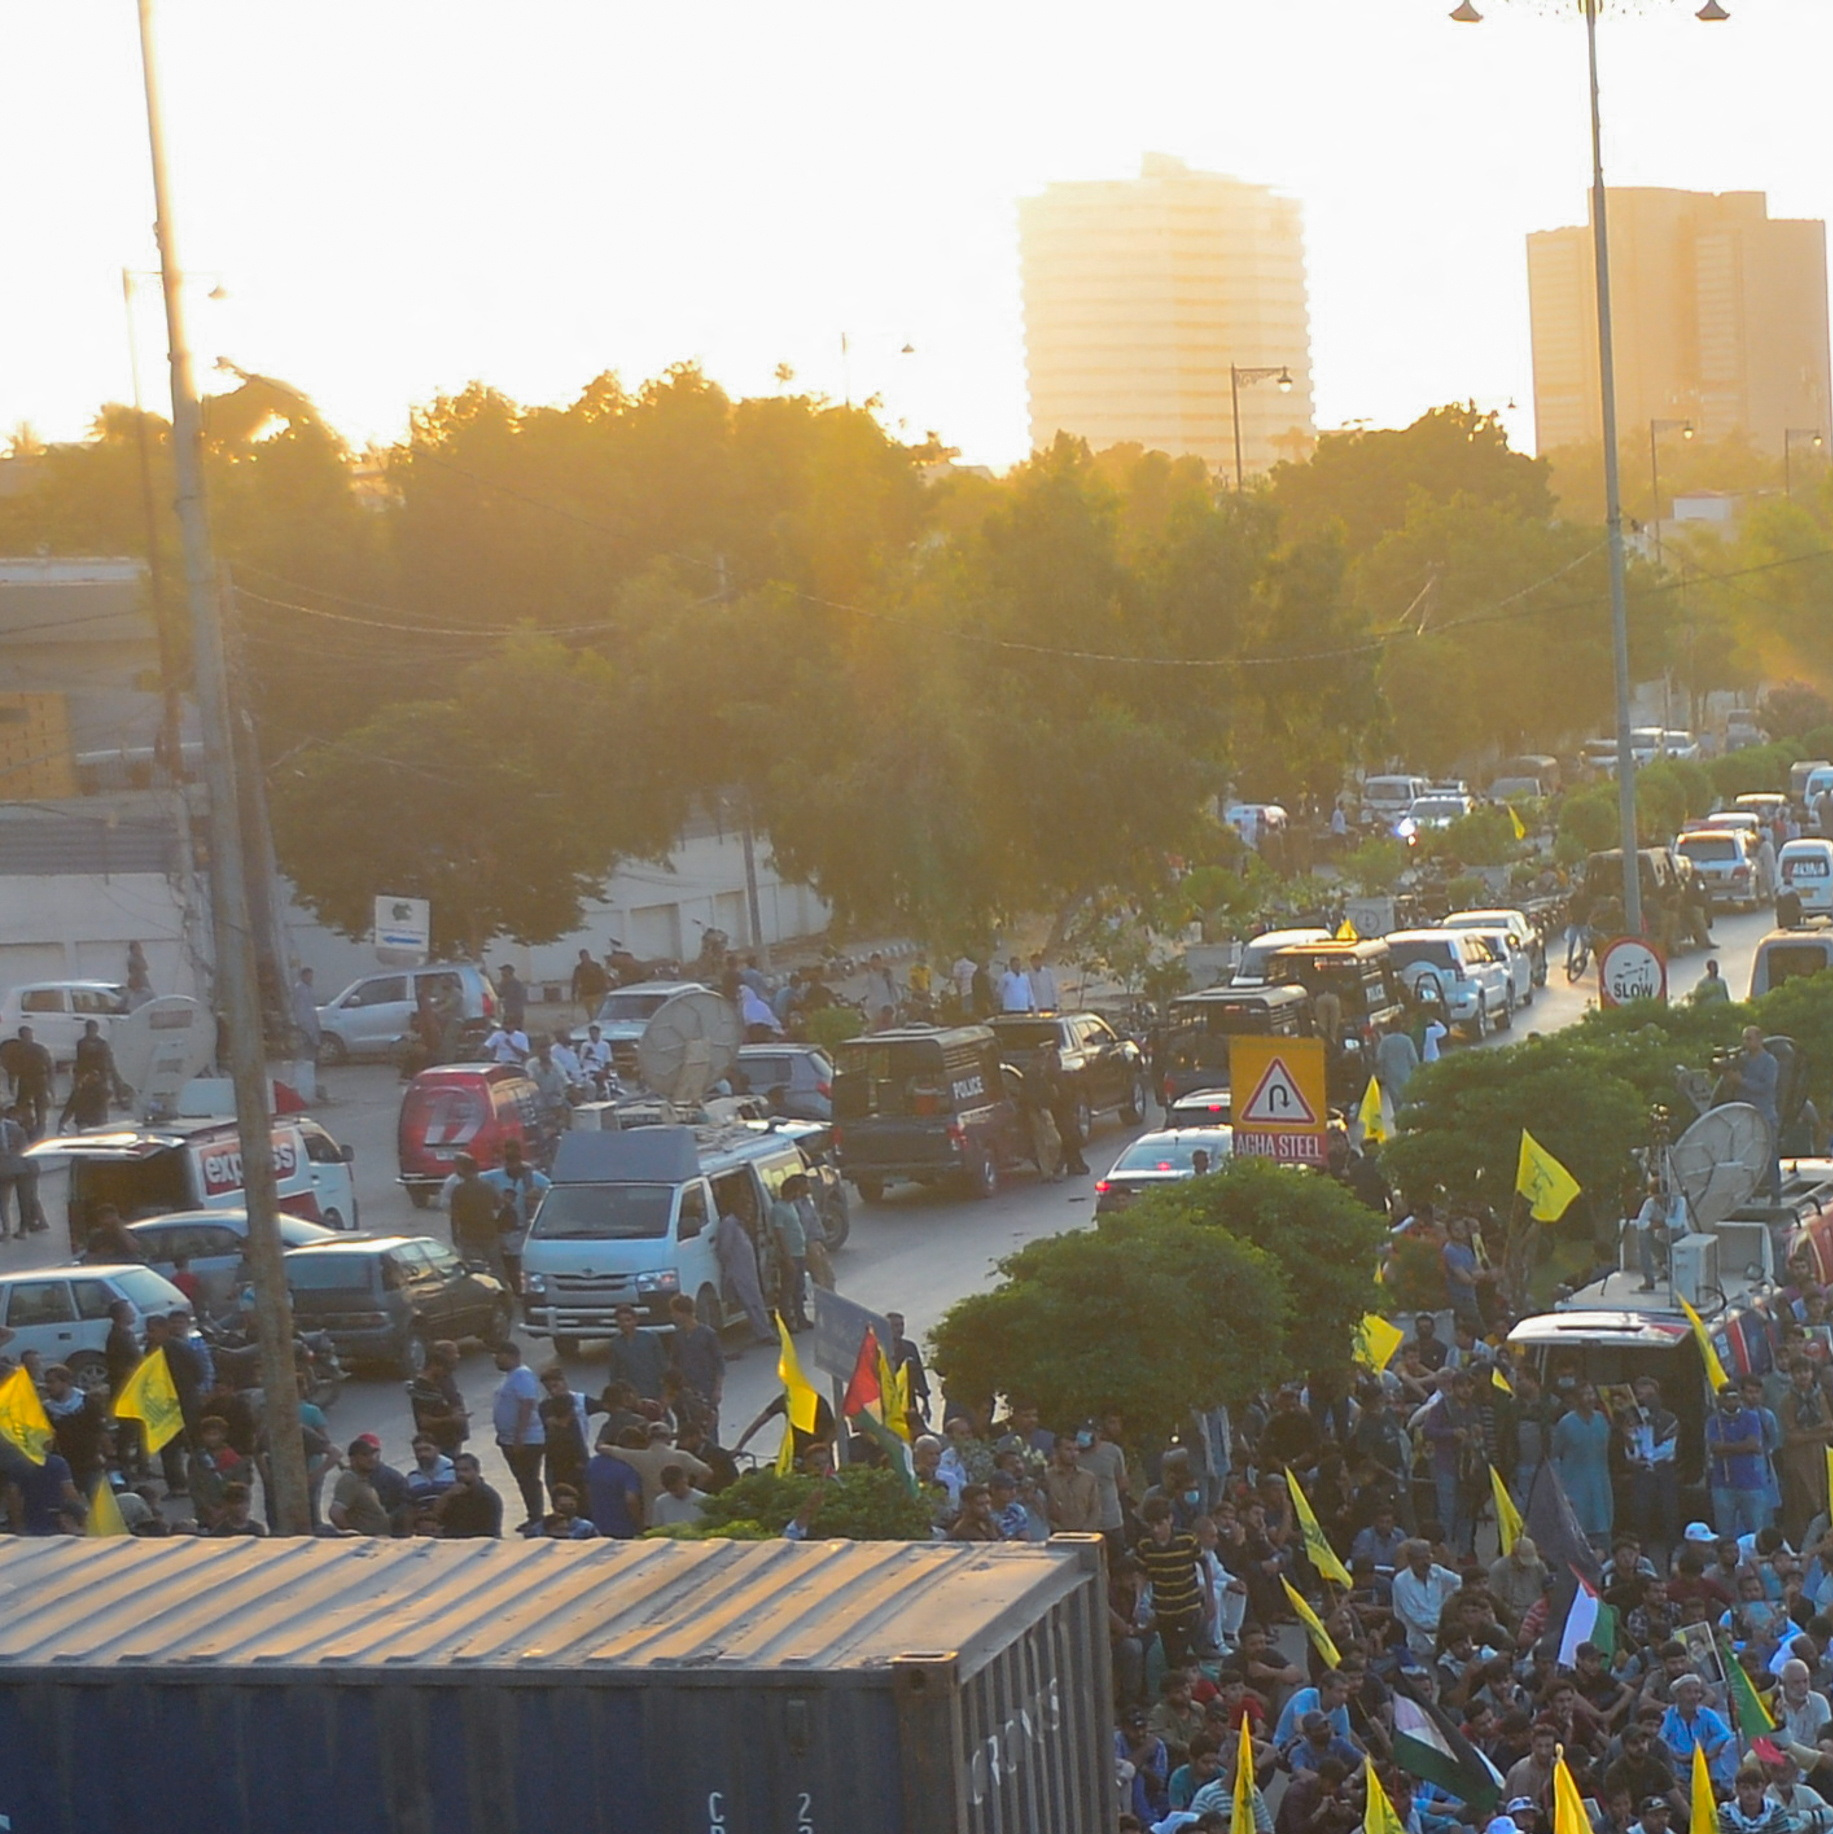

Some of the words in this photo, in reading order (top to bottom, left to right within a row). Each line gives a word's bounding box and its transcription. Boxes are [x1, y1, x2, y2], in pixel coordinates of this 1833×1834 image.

[1613, 982, 1653, 999] SLOW
[952, 1075, 985, 1100] POLICE
[1236, 1134, 1276, 1156] AGHA
[1278, 1135, 1323, 1158] STEEL
[204, 1141, 296, 1184] expss
